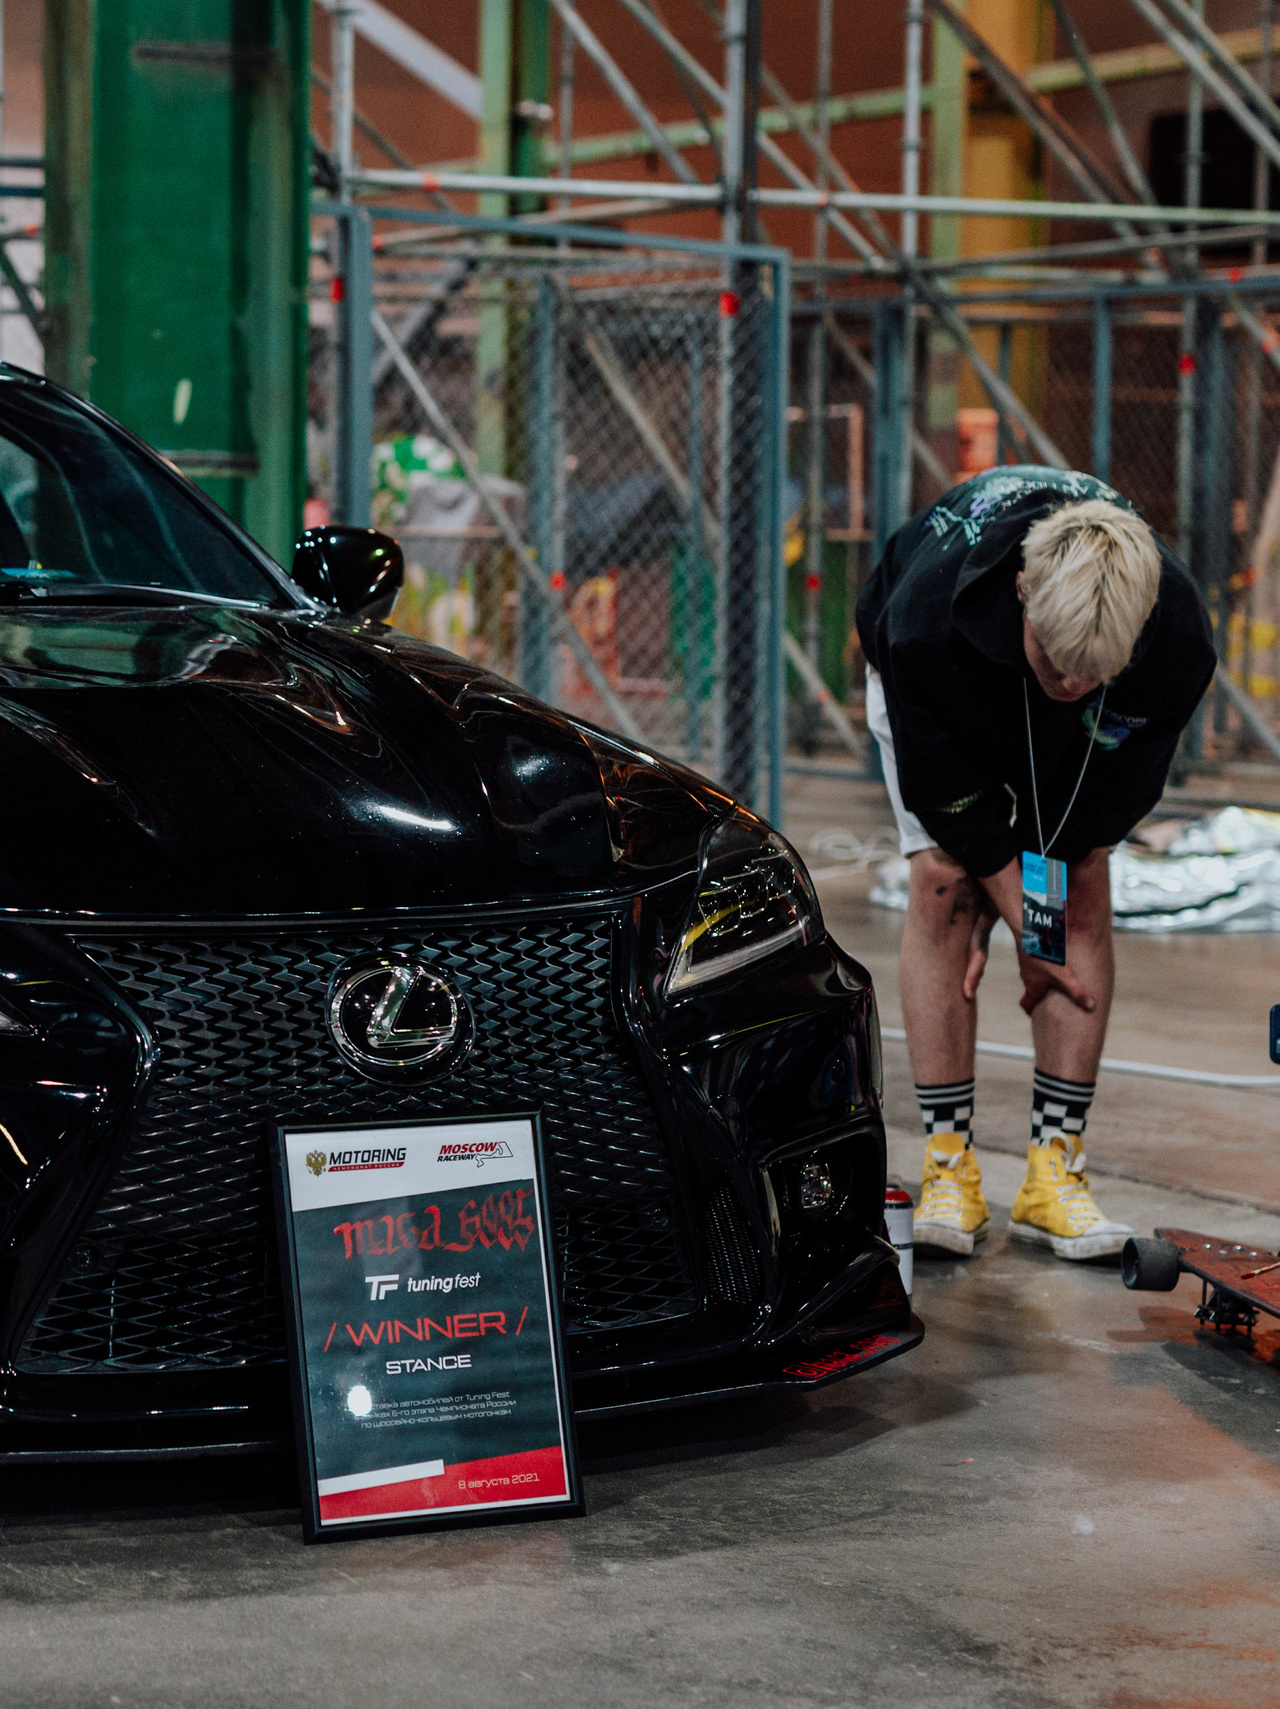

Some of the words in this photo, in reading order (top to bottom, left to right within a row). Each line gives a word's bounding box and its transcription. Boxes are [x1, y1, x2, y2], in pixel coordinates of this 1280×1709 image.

[439, 1142, 498, 1155] MOSCOW
[329, 1148, 407, 1165] MOTORING
[437, 1153, 476, 1162] RACEWAY
[365, 1274, 399, 1301] TF
[386, 1354, 472, 1375] STANCE
[465, 1393, 491, 1401] Tuning
[491, 1391, 510, 1399] Fest
[486, 1400, 517, 1408] России
[458, 1480, 466, 1489] 8
[468, 1478, 510, 1489] августа
[512, 1473, 540, 1484] 2021
